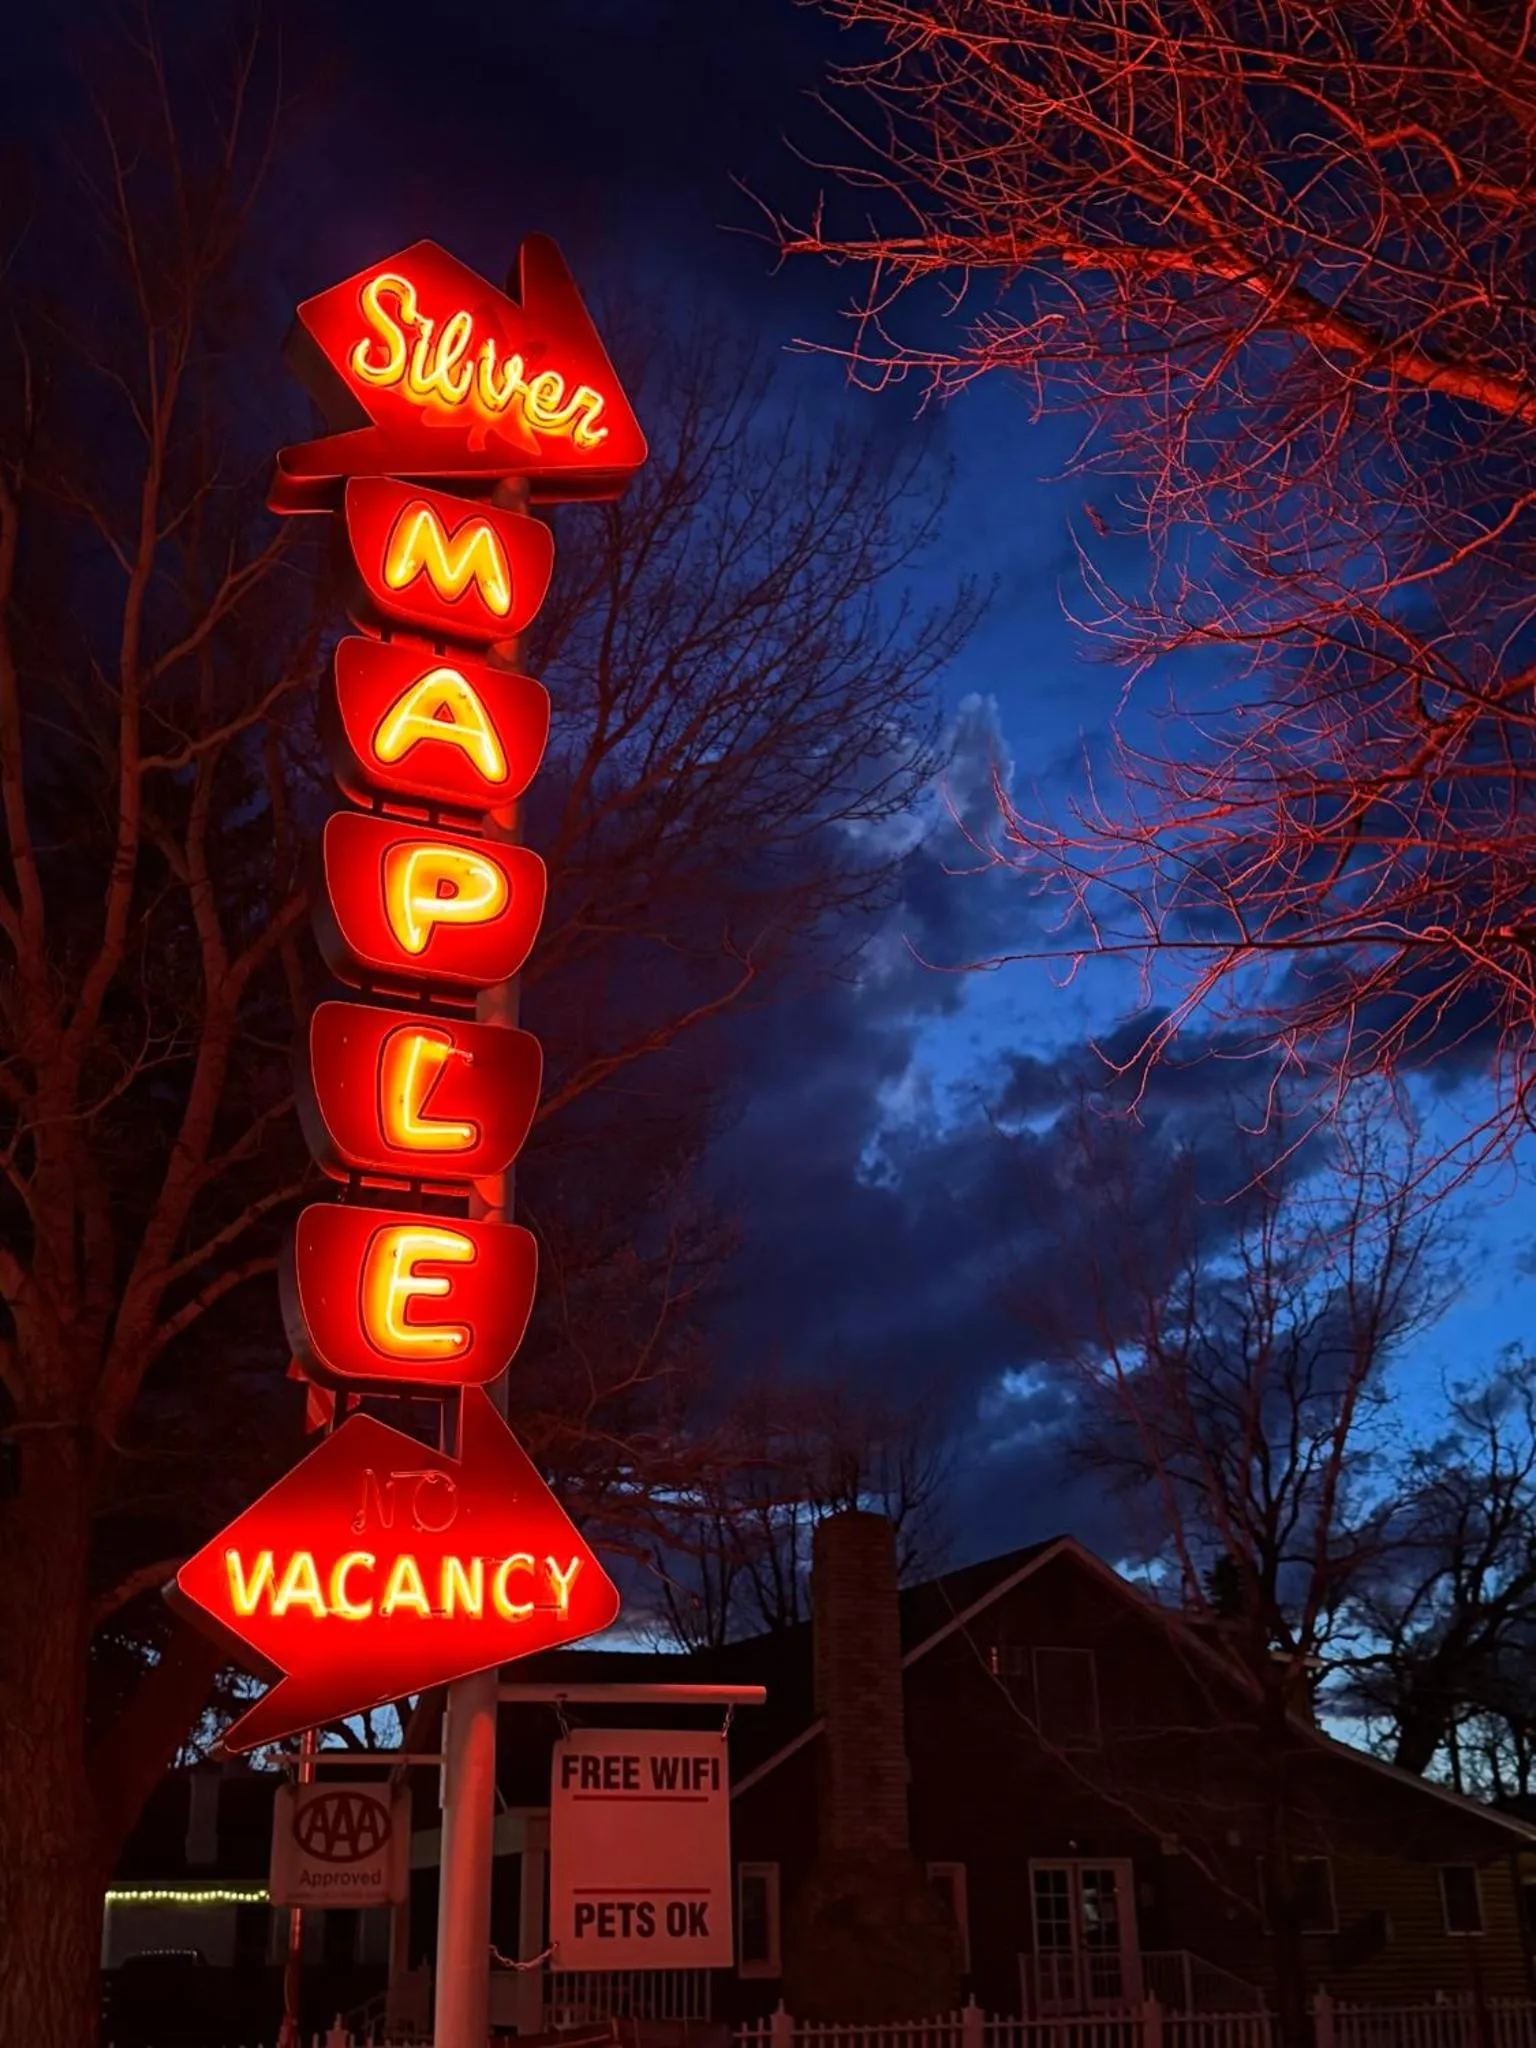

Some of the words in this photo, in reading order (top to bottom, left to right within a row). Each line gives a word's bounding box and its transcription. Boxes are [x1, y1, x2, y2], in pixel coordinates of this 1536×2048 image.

[350, 273, 608, 450] Silver
[360, 498, 511, 1362] MAPLE
[351, 1468, 459, 1535] NO
[224, 1548, 584, 1620] VACANCY
[562, 1754, 641, 1790] FREE
[650, 1756, 720, 1791] WIFI
[298, 1796, 386, 1859] AAA
[299, 1868, 382, 1888] Approved
[574, 1901, 656, 1939] PETS
[666, 1901, 710, 1938] OK
